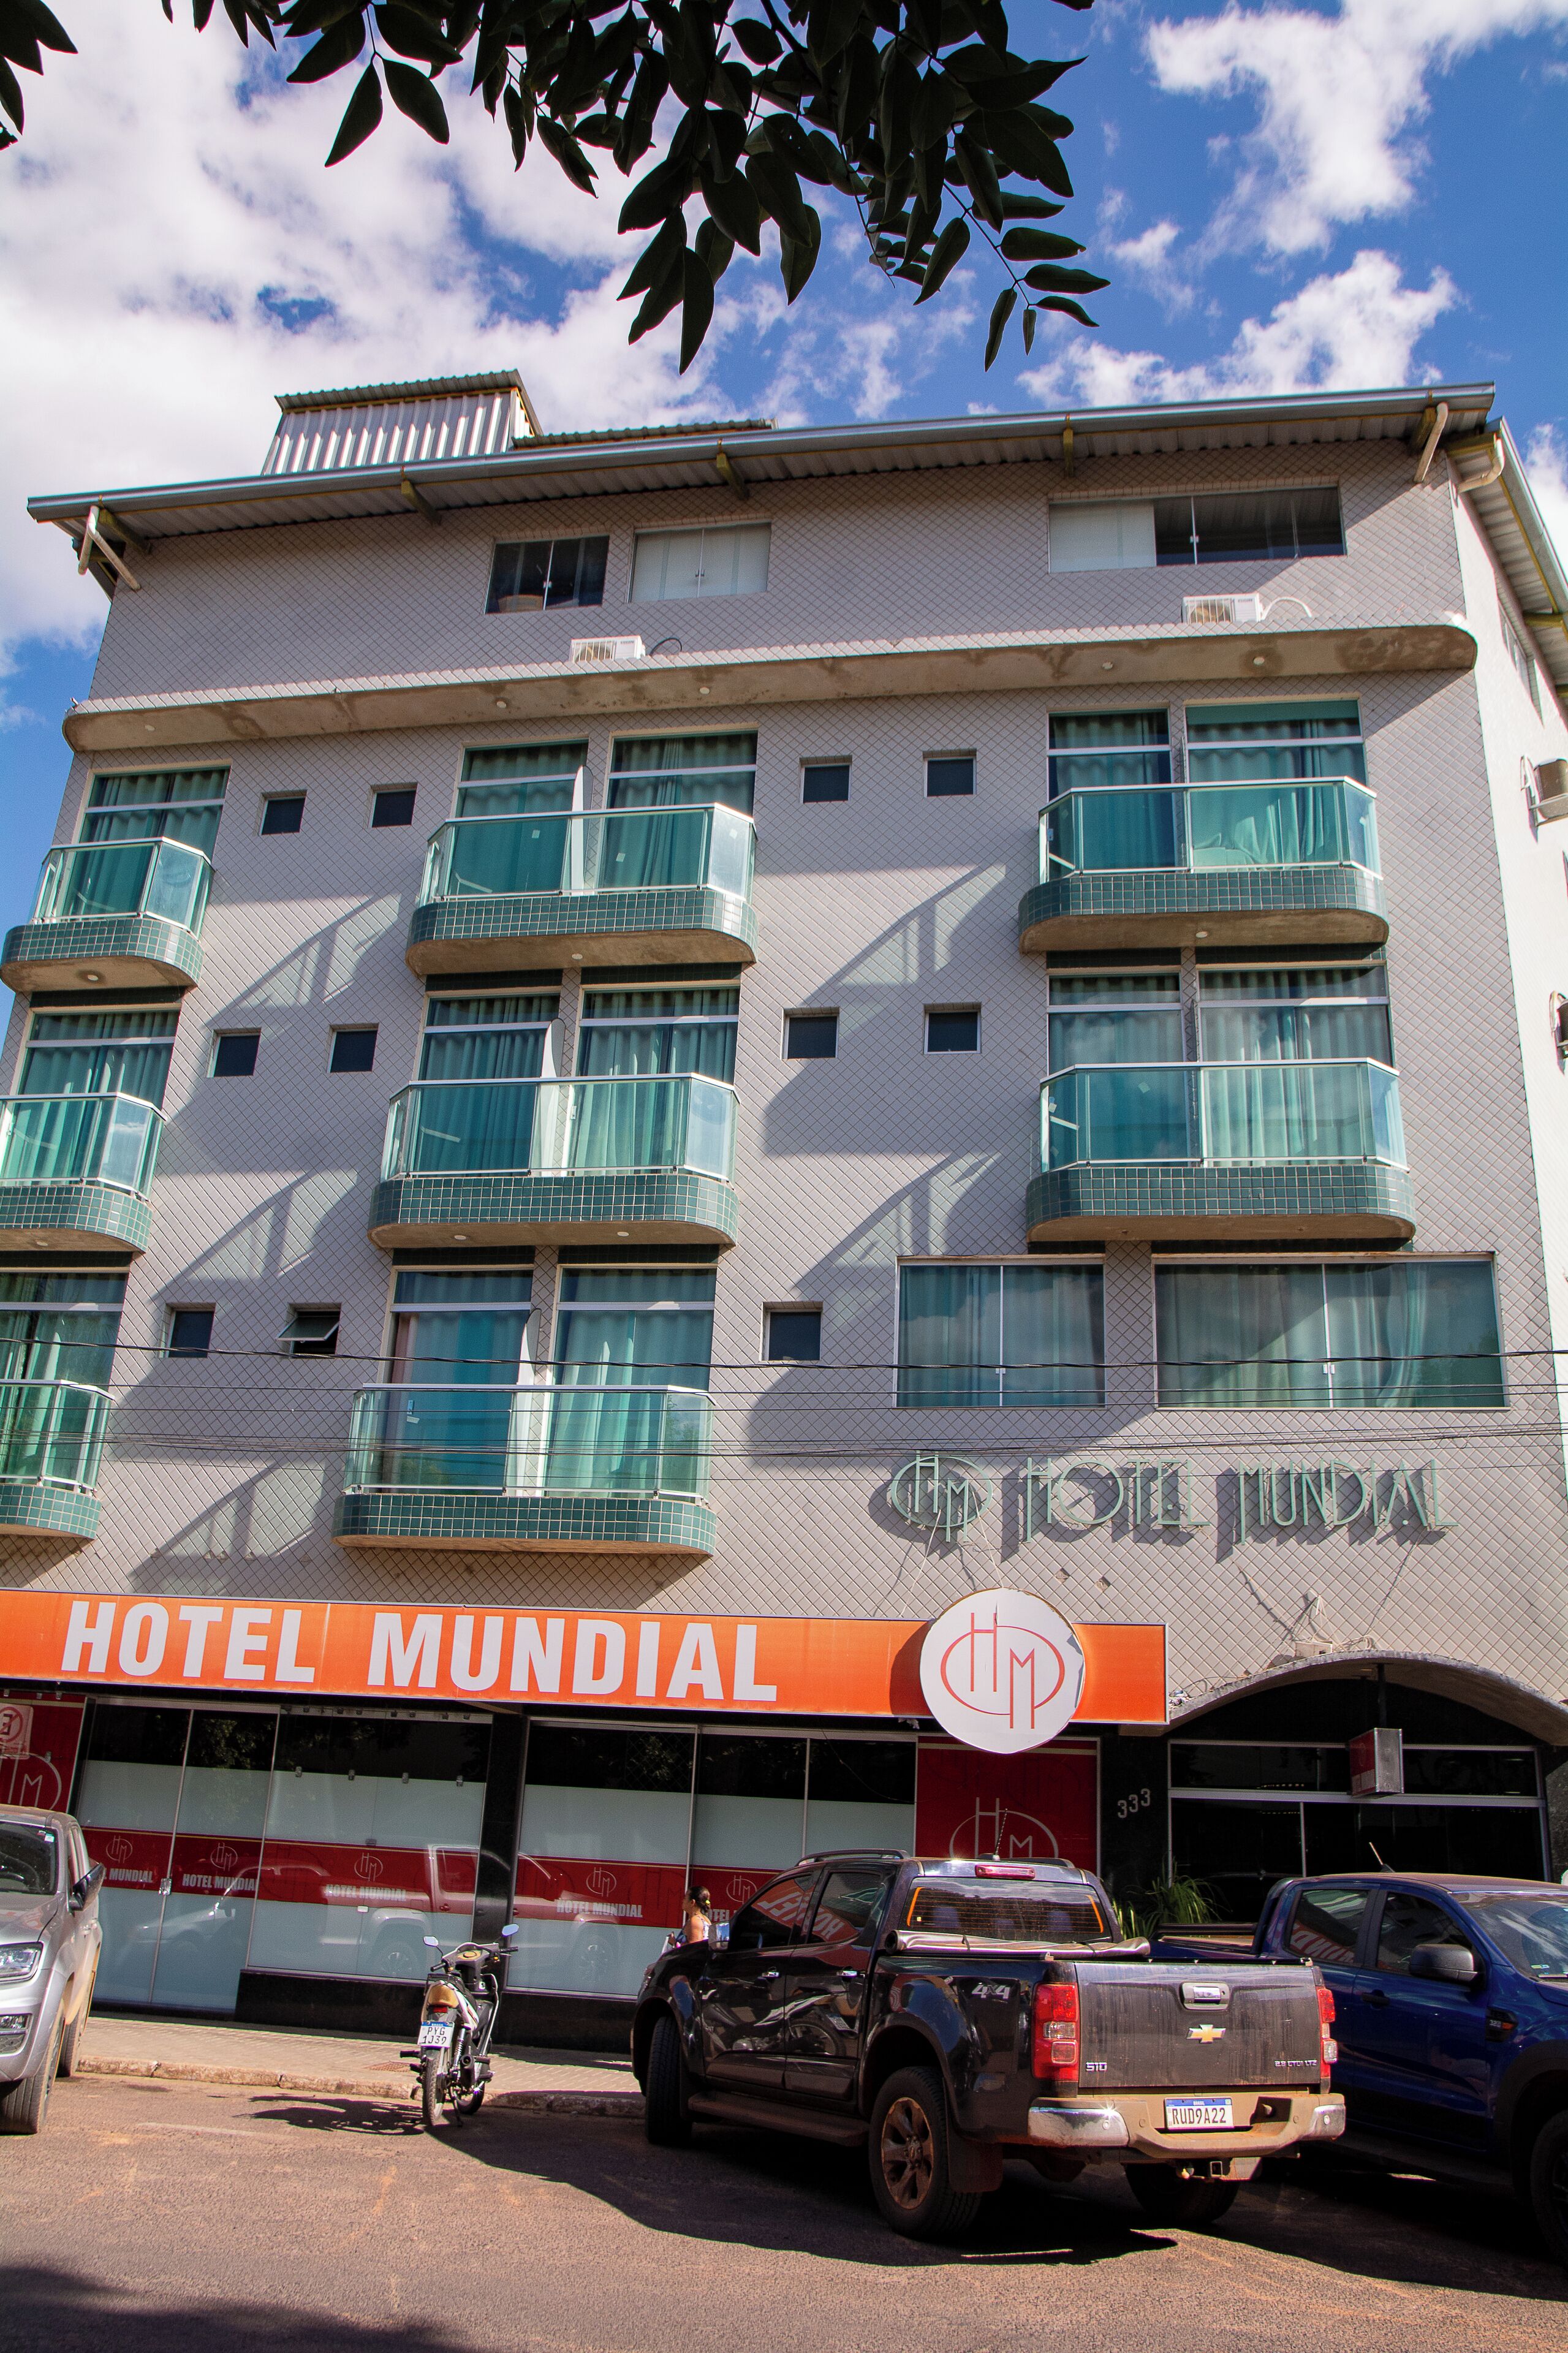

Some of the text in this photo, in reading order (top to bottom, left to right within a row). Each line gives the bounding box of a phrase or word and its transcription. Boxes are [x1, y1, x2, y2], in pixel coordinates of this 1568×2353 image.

[1026, 1458, 1460, 1545] HOTEL MUNDIAL
[61, 1601, 777, 1701] HOTEL MUNDIAL
[1117, 1788, 1151, 1818] 333
[109, 1868, 153, 1883] MUNDIAL
[182, 1873, 212, 1888] HOTEL
[325, 1884, 407, 1902] HOTEL MUNDIAL
[556, 1898, 643, 1918] HOTEL MUNDIAL
[427, 2026, 445, 2036] PYG
[422, 2035, 447, 2045] 1J39
[1086, 2062, 1107, 2071] S10
[1172, 2107, 1226, 2124] RUD9A22
